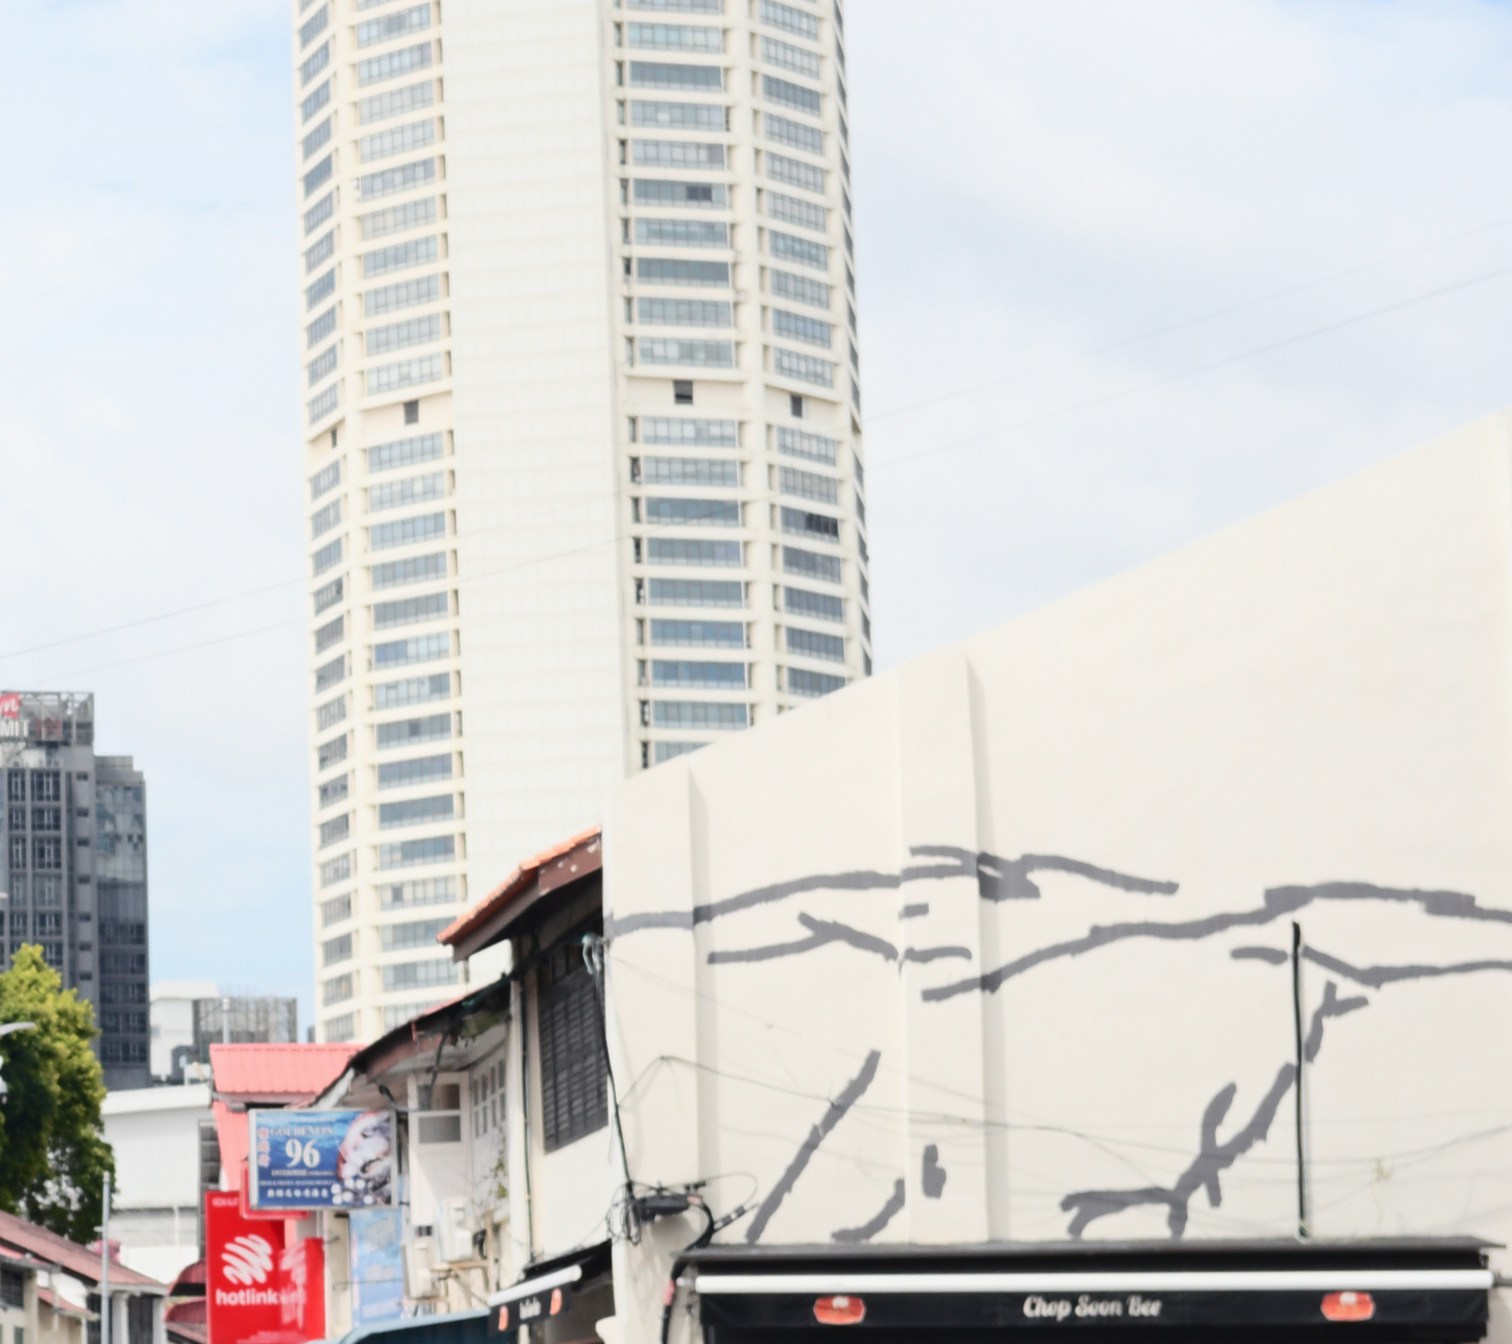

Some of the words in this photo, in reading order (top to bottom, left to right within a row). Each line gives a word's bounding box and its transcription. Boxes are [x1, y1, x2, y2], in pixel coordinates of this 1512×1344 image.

[285, 1138, 321, 1168] 96
[1023, 1294, 1073, 1323] Chop
[1075, 1294, 1123, 1317] Soon
